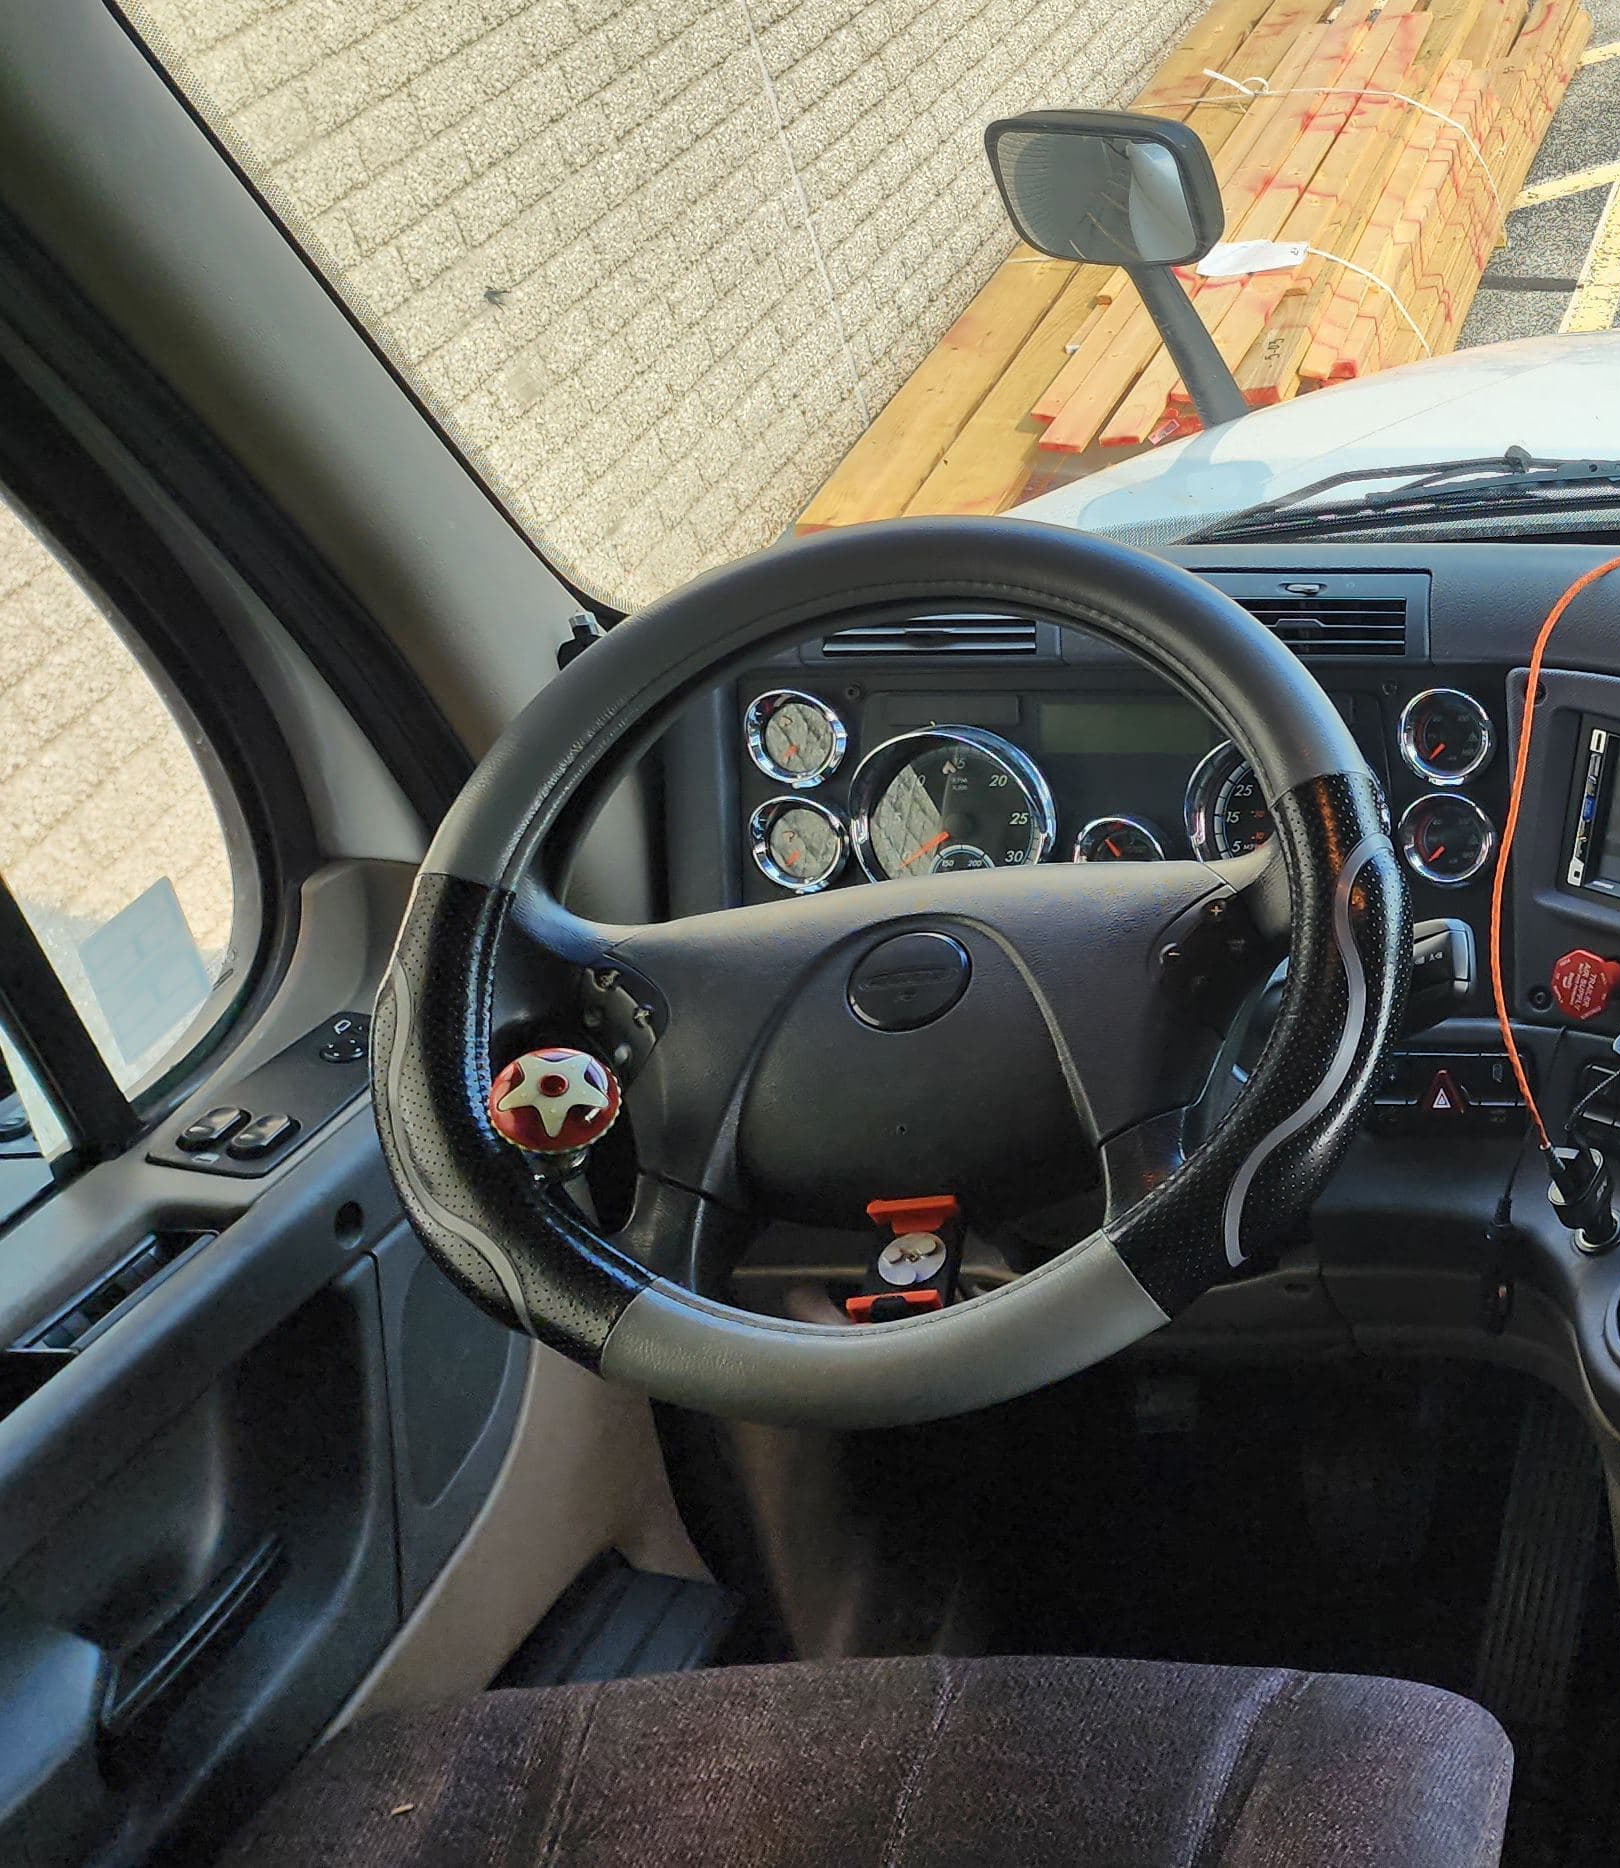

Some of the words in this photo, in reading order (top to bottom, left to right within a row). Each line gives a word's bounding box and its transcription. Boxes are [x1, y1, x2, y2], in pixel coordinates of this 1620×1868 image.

[989, 775, 1008, 787] 20
[1234, 784, 1254, 798] 25
[1009, 812, 1029, 825] 25
[1226, 811, 1241, 824] 15
[1231, 840, 1242, 853] 5
[1005, 850, 1024, 863] 30
[1582, 974, 1597, 1007] TRAILER
